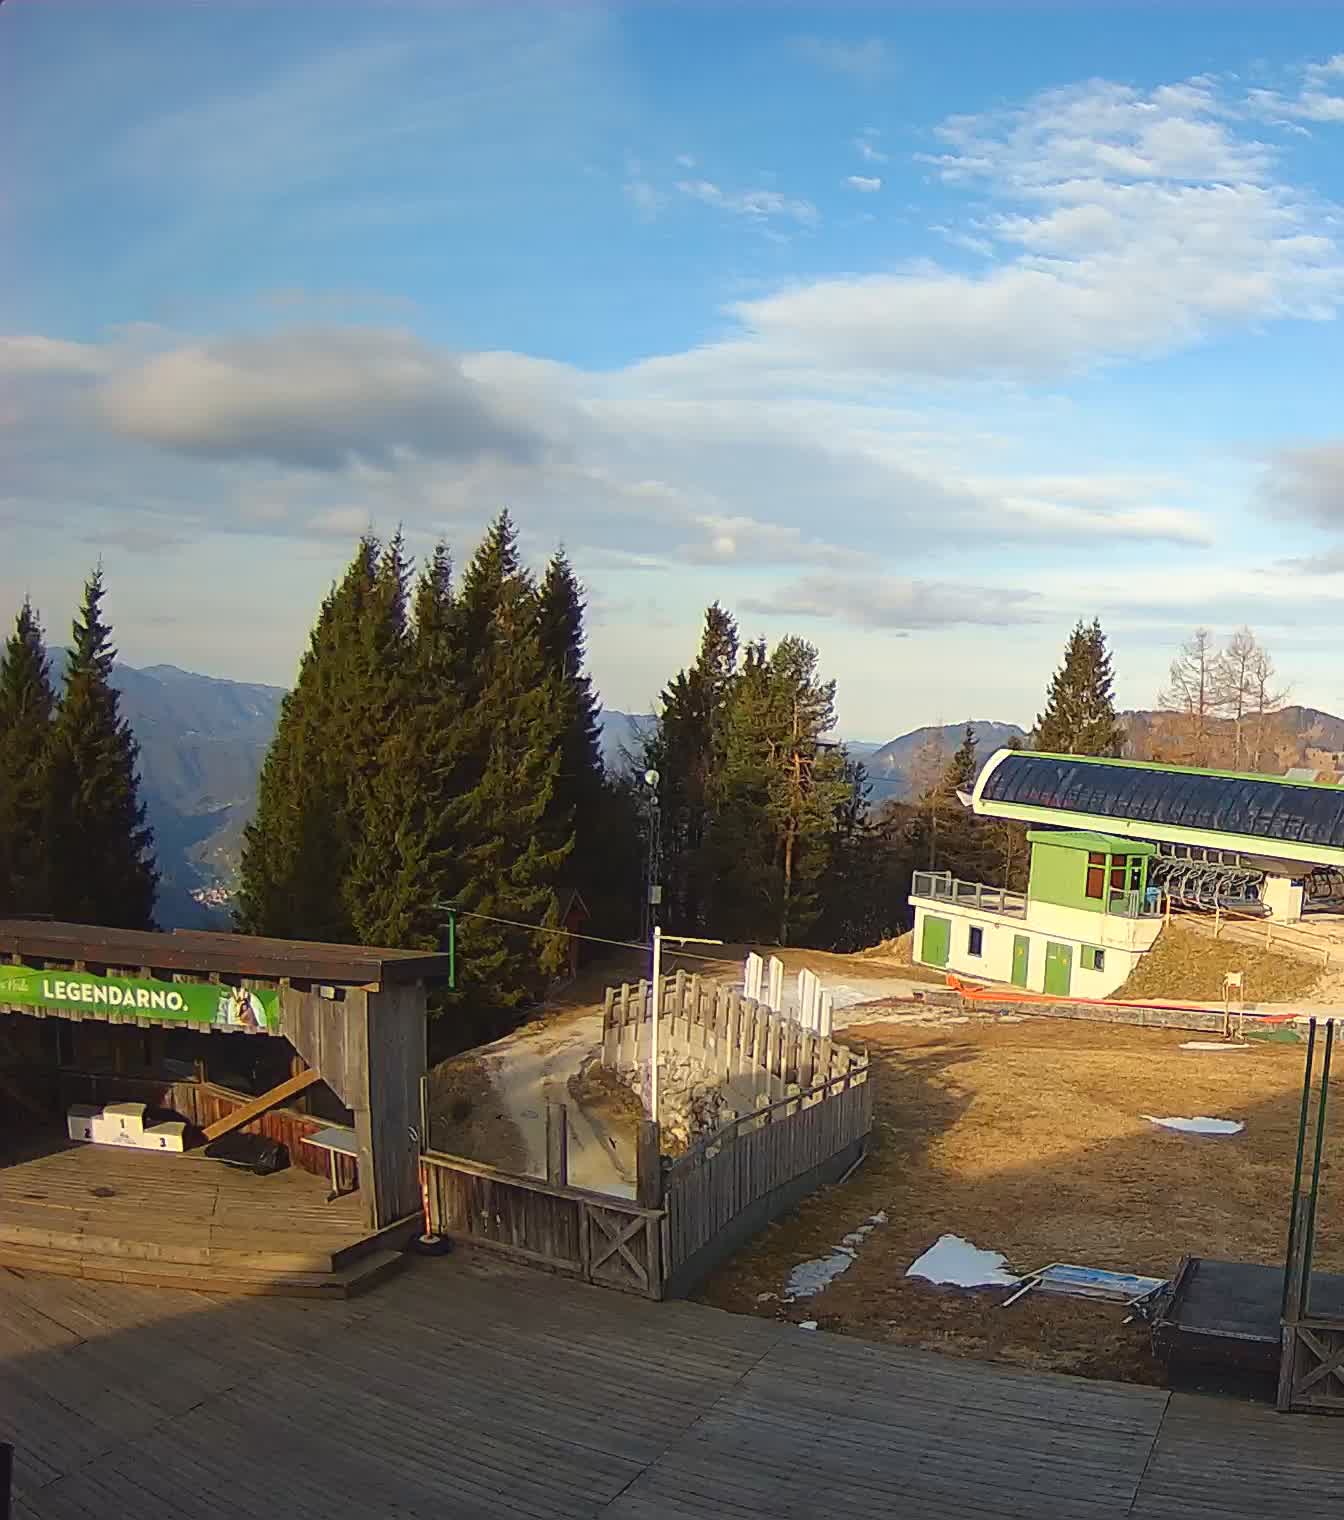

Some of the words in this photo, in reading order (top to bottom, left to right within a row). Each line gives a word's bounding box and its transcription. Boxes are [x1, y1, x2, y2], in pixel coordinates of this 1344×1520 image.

[43, 979, 188, 1011] LEGENDARNO.
[120, 1118, 125, 1129] 1
[84, 1128, 91, 1139] 2
[160, 1138, 166, 1147] 3
